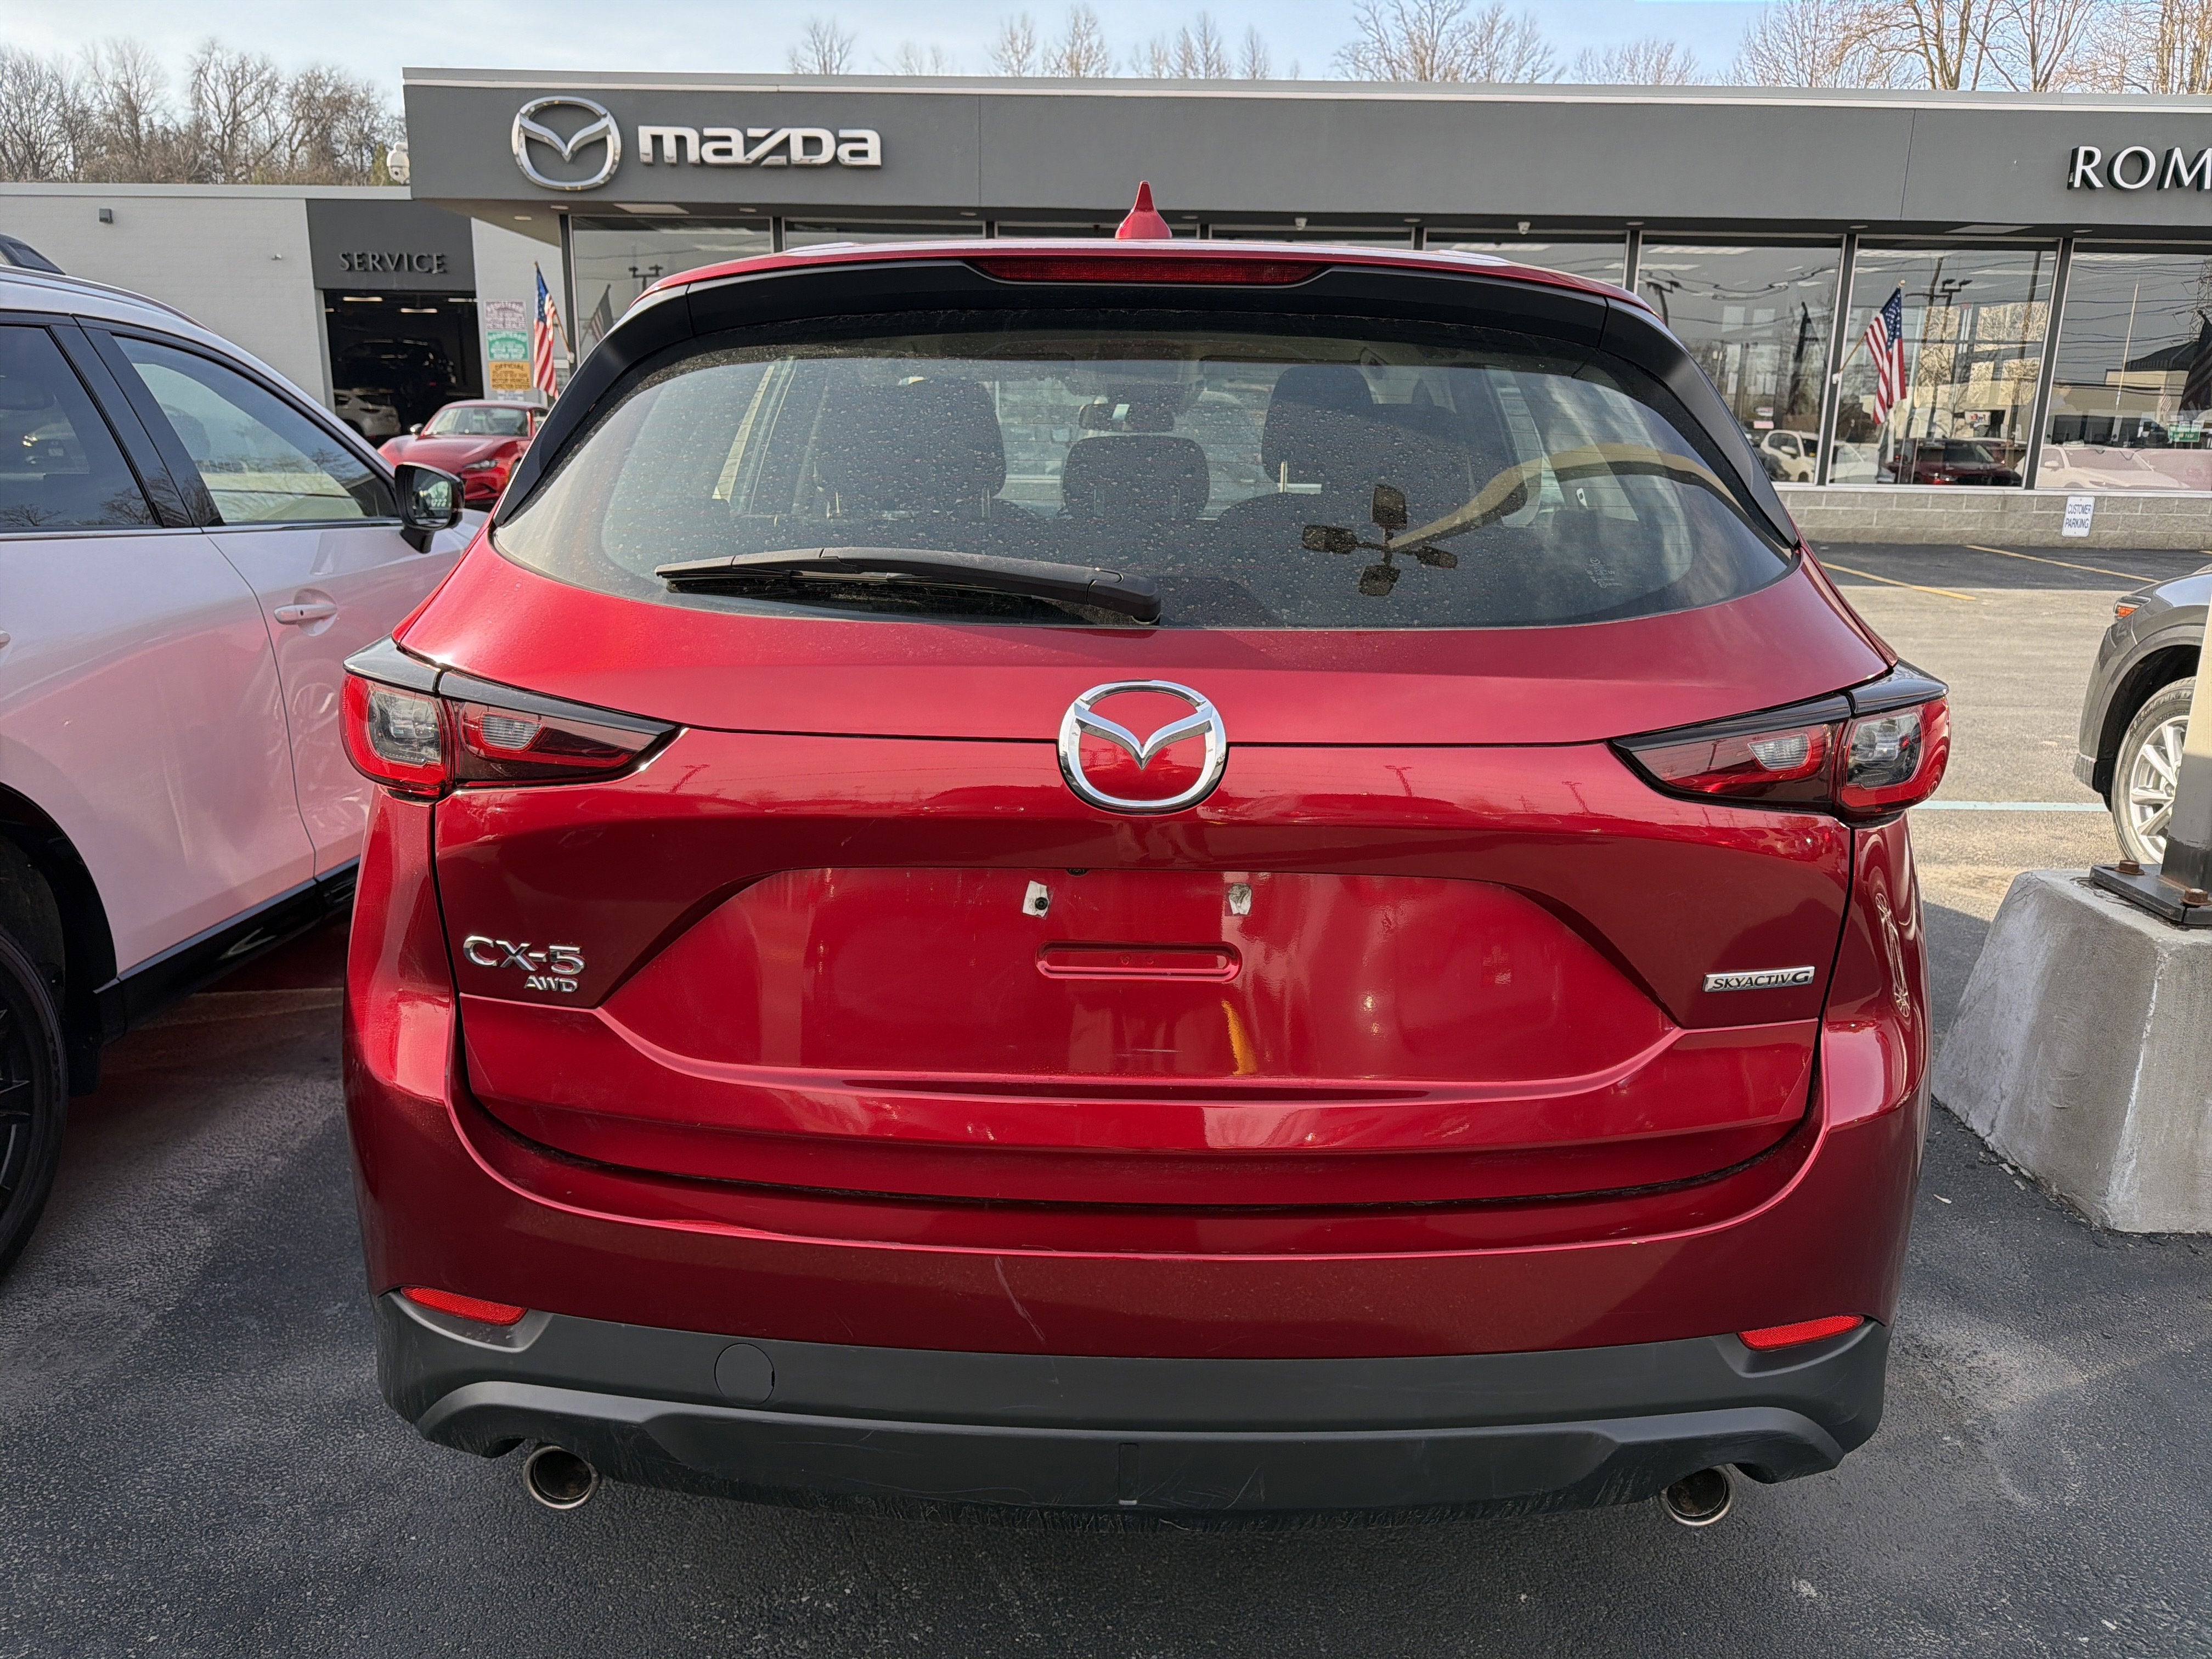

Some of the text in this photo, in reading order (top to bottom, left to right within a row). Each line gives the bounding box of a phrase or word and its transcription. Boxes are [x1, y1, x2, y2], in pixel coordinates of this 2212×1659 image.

[2068, 145, 2212, 190] ROM
[338, 251, 447, 274] SERVICE
[2068, 504, 2092, 515] CUSTOMER
[2065, 518, 2089, 528] PARKING
[463, 935, 586, 975] CX-5
[523, 975, 579, 992] AWD
